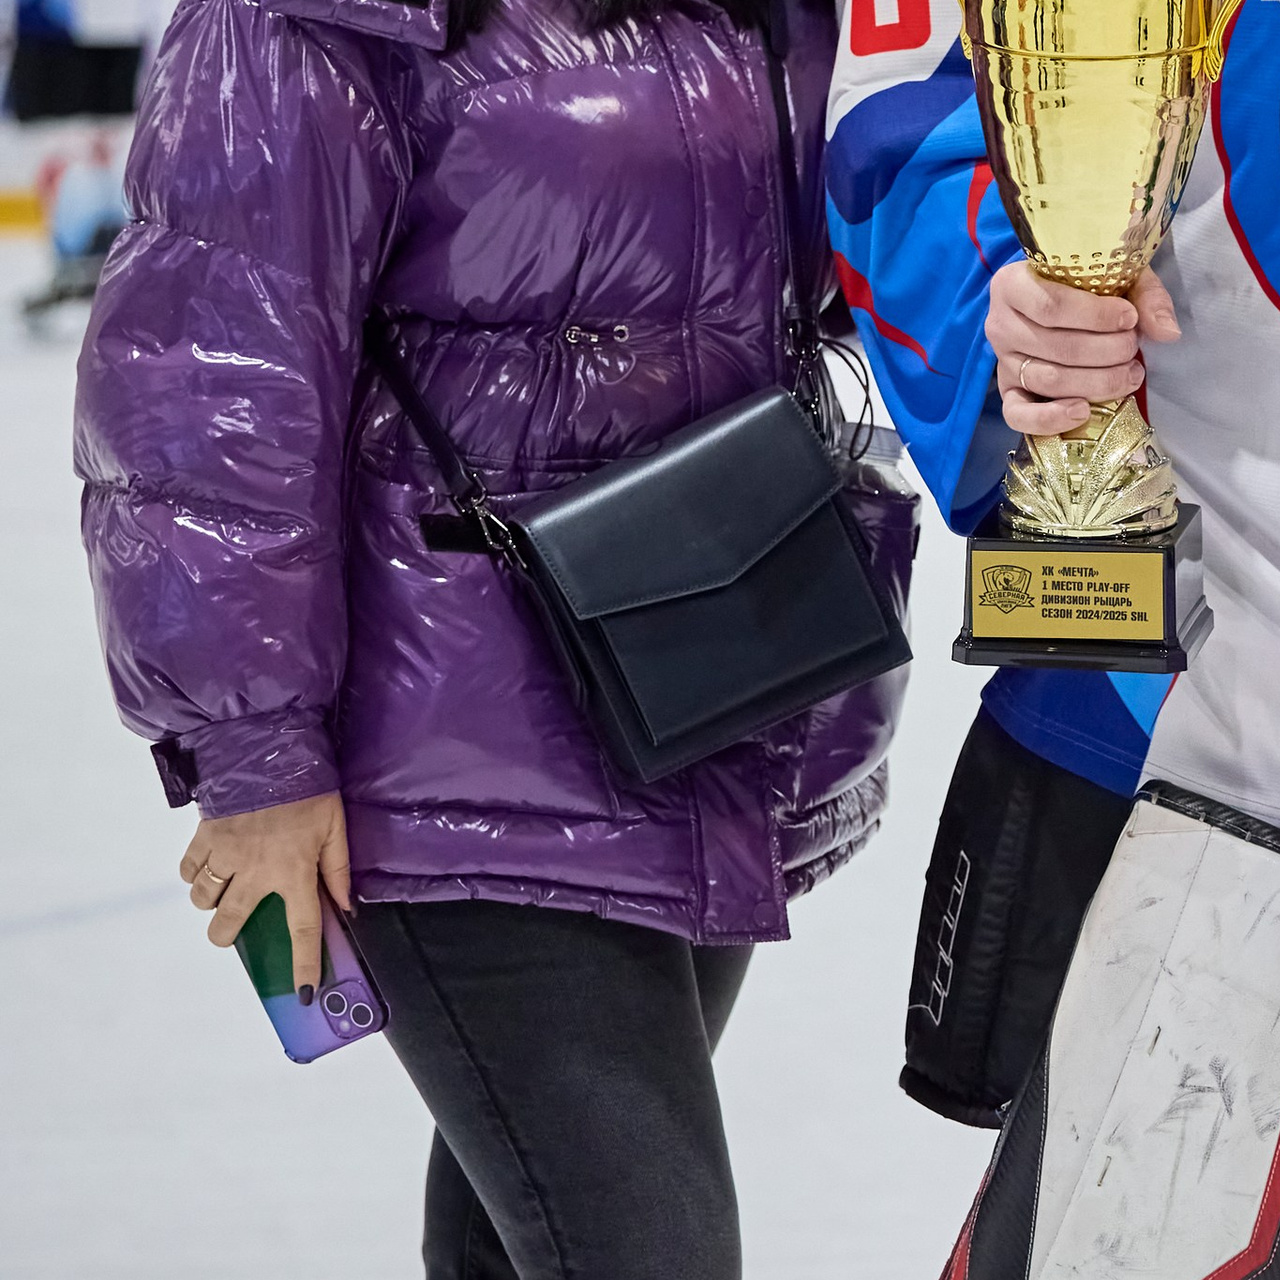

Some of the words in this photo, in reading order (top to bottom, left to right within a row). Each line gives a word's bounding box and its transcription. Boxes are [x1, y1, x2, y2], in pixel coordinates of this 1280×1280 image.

[1041, 566, 1054, 577] ХК
[1058, 566, 1099, 577] «МЕЧТА»
[1042, 580, 1048, 590] 1
[1051, 581, 1083, 591] МЕСТО
[1087, 582, 1130, 593] PLAY-OFF
[988, 591, 1026, 600] СЕВЕРНАЯ
[1041, 594, 1090, 605] ДИВИЗИОН
[1094, 596, 1132, 607] РЫЦАРЬ
[1041, 608, 1072, 619] СЕЗОН
[1076, 609, 1127, 621] 2024/2025
[1131, 611, 1149, 622] SHL
